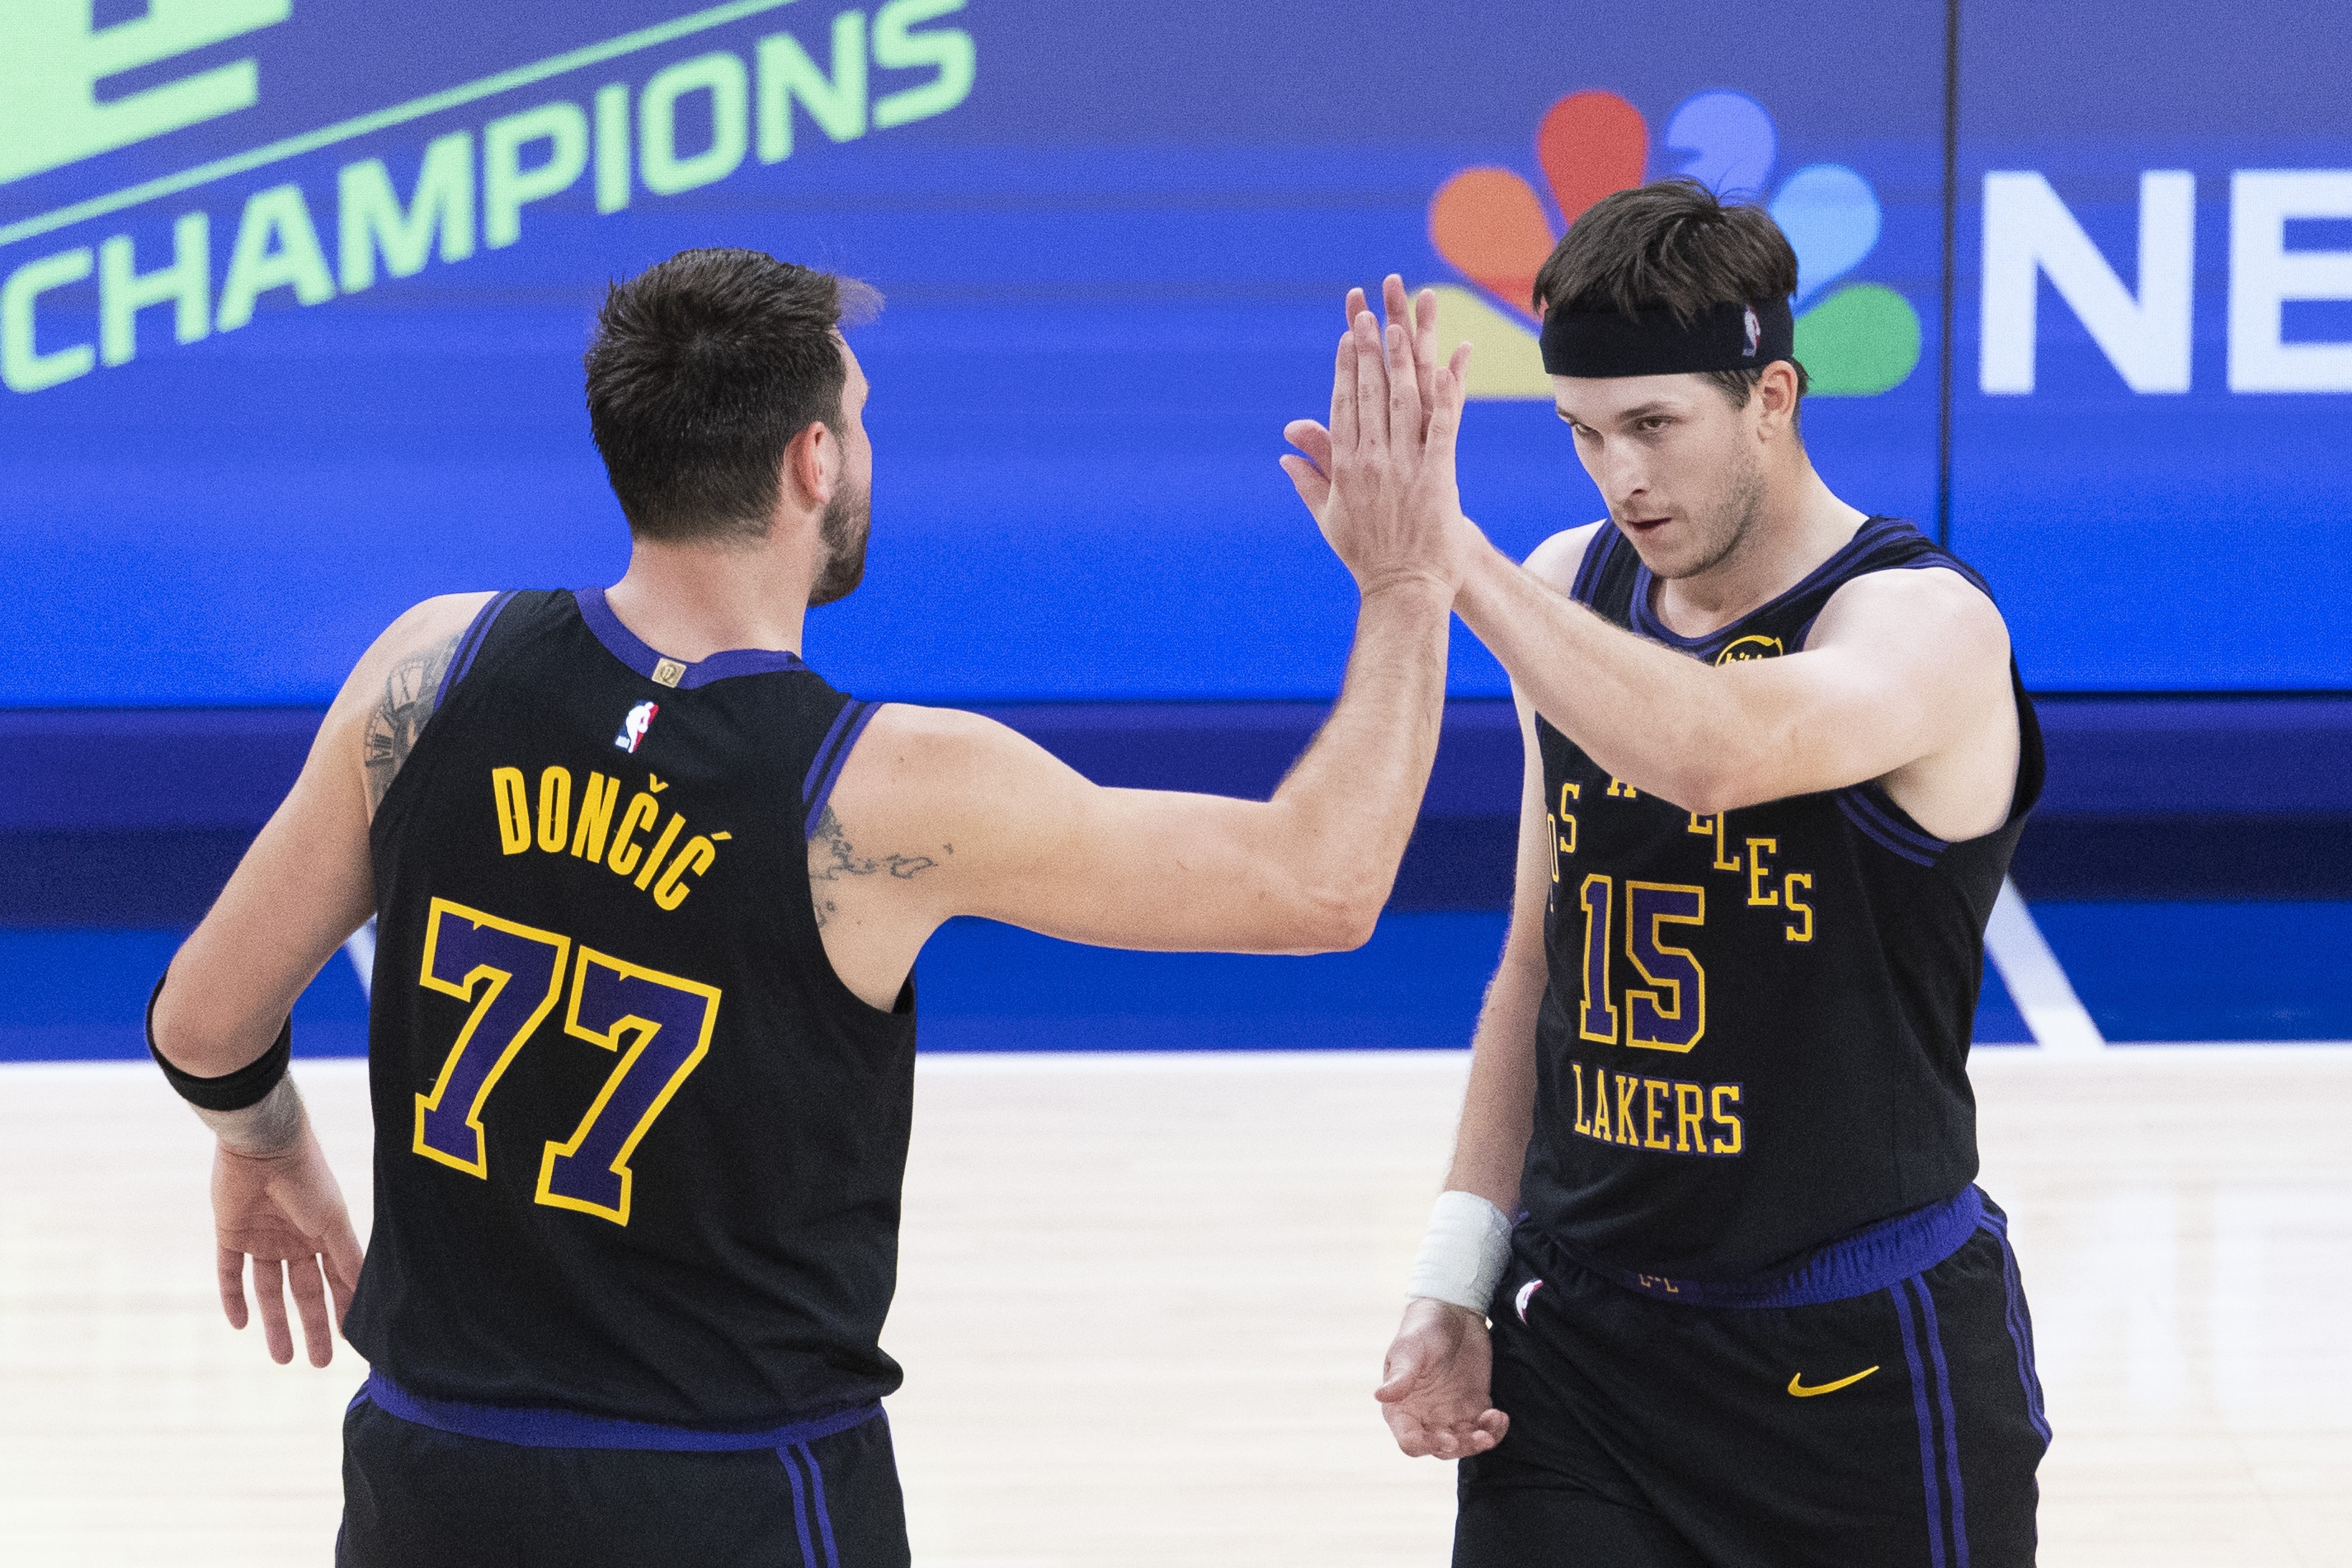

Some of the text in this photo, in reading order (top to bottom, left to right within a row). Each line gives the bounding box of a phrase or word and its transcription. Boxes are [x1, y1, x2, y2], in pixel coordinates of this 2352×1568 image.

[0, 0, 976, 393] CHAMPIONS
[493, 765, 731, 911] DONČIĆ
[1579, 873, 1705, 1052] 15
[412, 897, 722, 1227] 77
[1574, 1064, 1742, 1154] LAKERS
